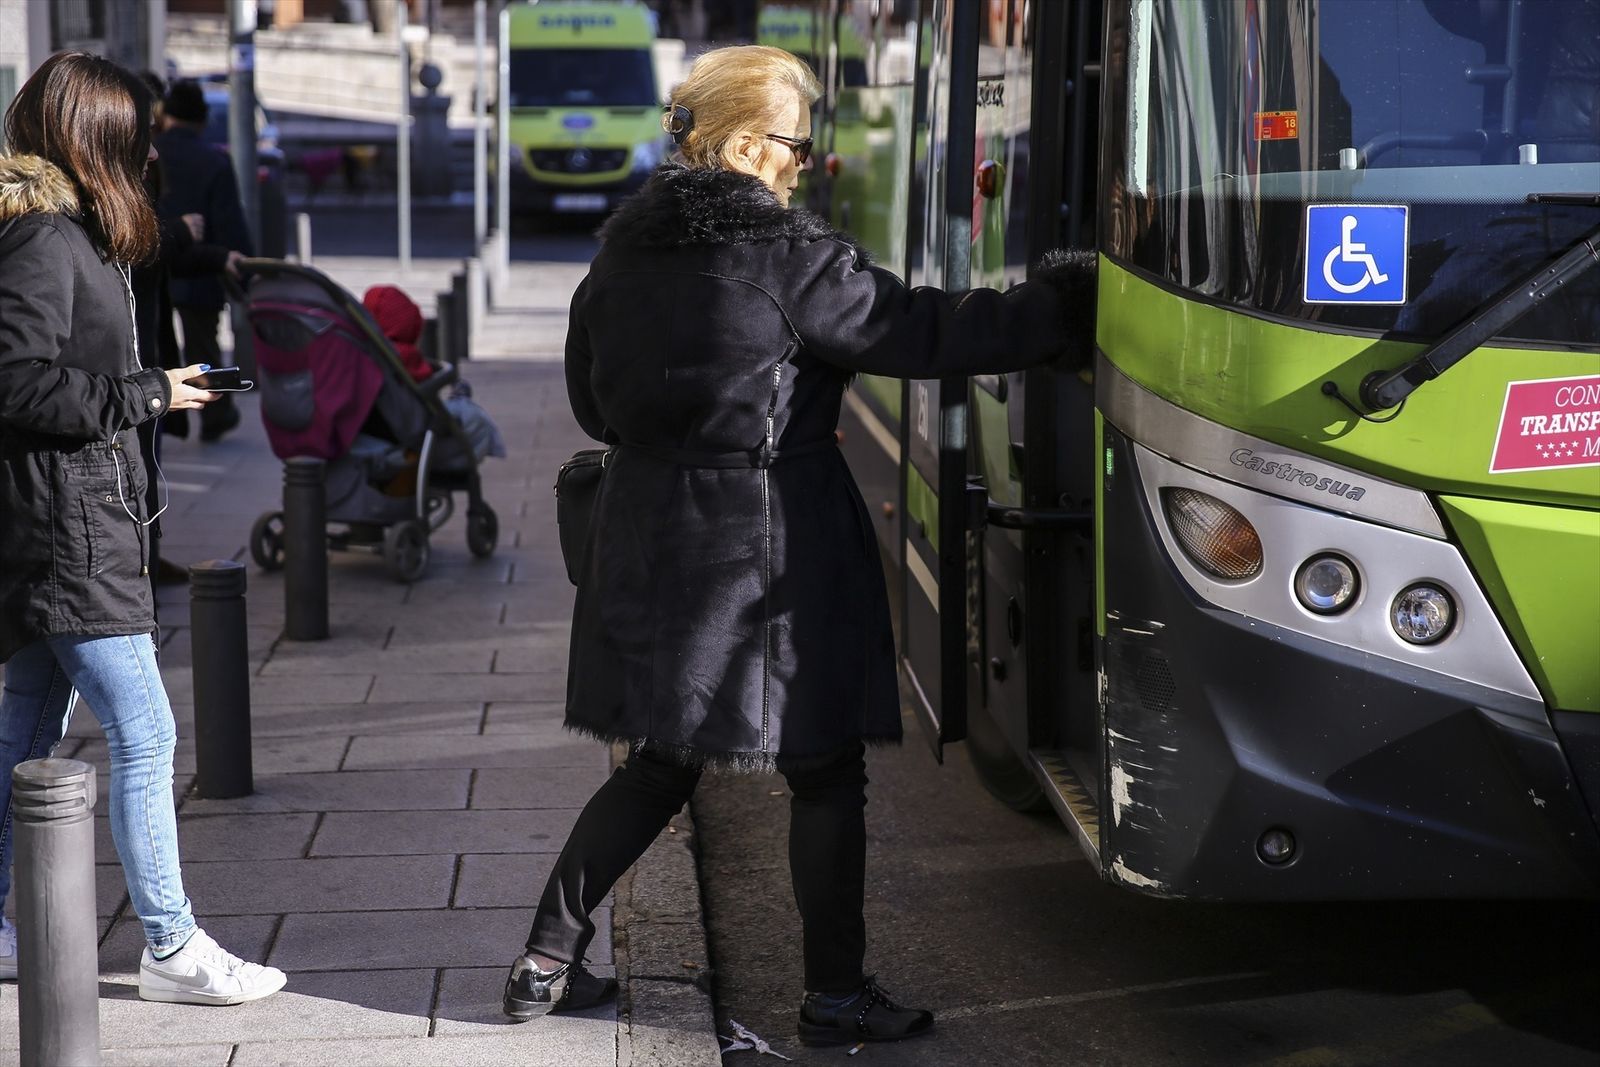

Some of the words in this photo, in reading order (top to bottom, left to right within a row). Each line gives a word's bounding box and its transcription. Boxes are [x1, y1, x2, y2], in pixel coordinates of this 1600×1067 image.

[1284, 118, 1296, 128] 18
[1520, 411, 1600, 436] TRANSP
[1229, 448, 1367, 501] Castrosua
